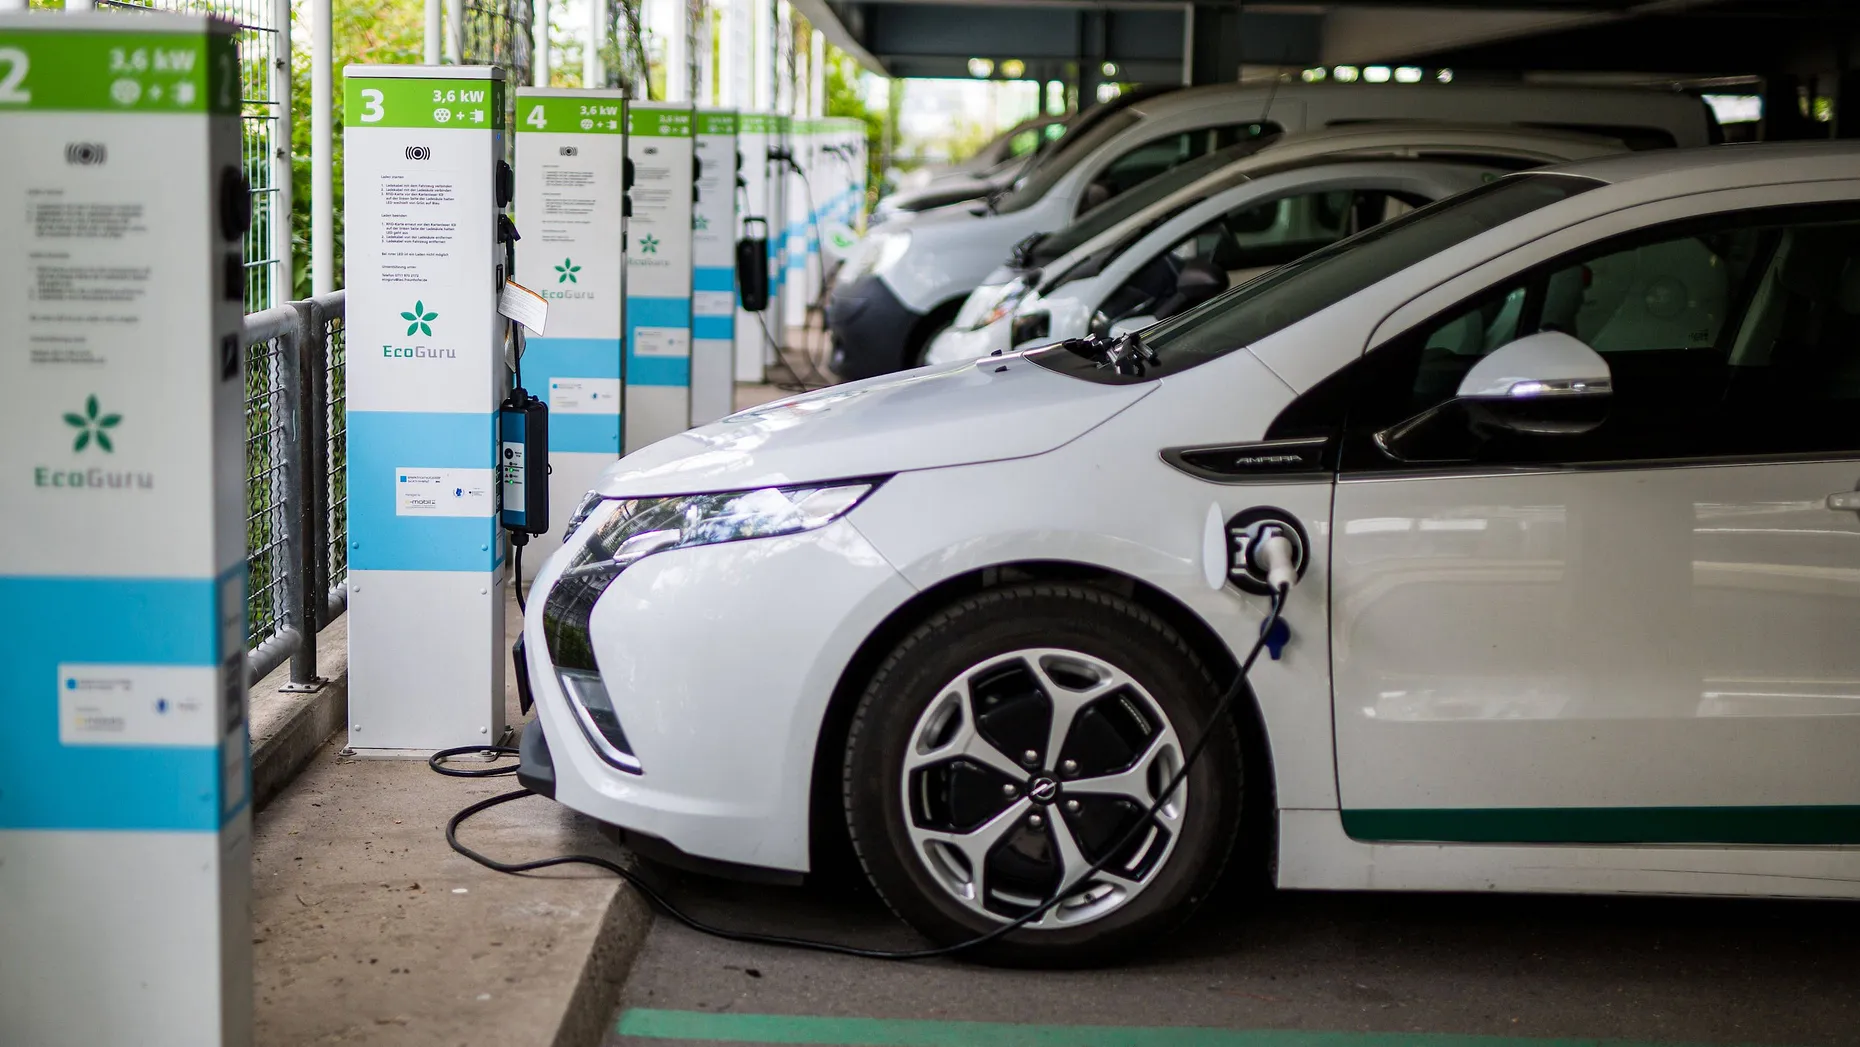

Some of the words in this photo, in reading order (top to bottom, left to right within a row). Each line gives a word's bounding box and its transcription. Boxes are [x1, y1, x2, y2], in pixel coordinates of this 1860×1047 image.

[109, 48, 148, 72] 3,6
[154, 49, 196, 72] kW
[0, 48, 31, 104] 2
[360, 88, 385, 122] 3
[432, 90, 456, 104] 3,6
[460, 90, 484, 103] kW
[526, 104, 548, 129] 4
[580, 106, 597, 116] 3,6
[600, 106, 618, 116] kW
[542, 289, 594, 300] EcoGuru
[382, 345, 456, 358] EcoGuru
[1236, 455, 1302, 464] AMPERA
[33, 466, 154, 490] EcoGuru
